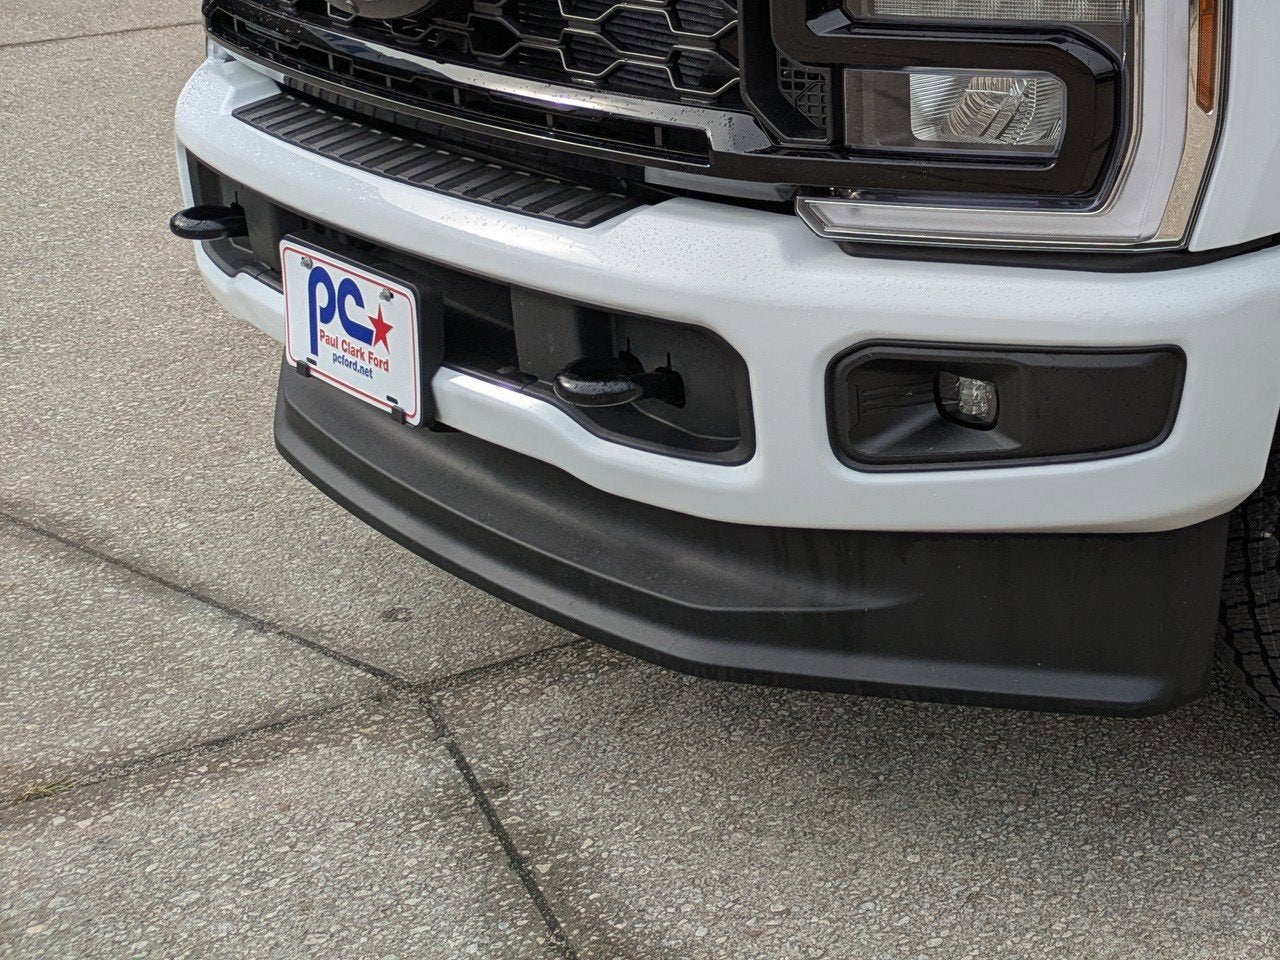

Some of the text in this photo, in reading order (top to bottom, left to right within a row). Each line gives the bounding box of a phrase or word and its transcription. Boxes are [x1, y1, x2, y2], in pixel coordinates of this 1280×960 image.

[319, 328, 389, 373] Paul Clark Ford
[332, 352, 374, 380] pcford.net
